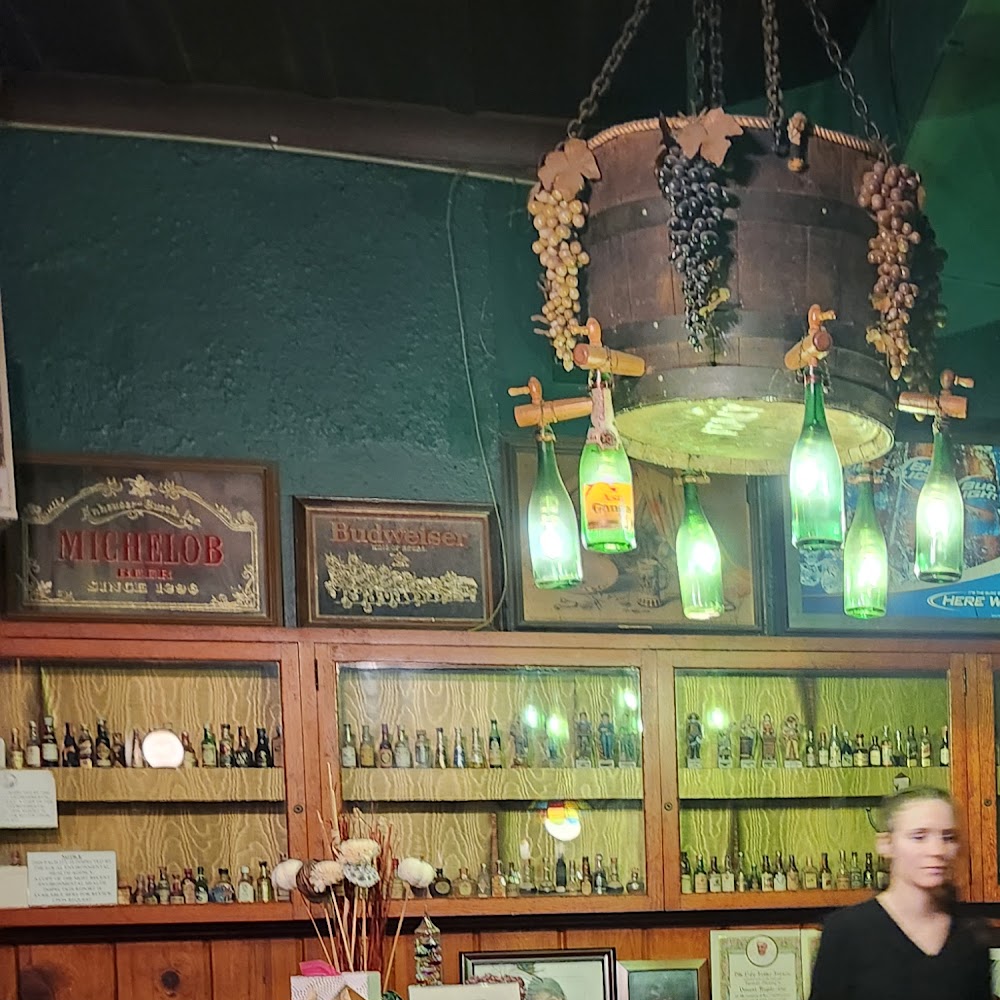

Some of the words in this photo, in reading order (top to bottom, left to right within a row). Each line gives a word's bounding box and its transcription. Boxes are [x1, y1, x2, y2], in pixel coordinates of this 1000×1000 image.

[963, 490, 998, 501] IGHT
[329, 520, 470, 548] Budweiser
[58, 529, 225, 567] MICHELOB
[87, 580, 148, 595] SINCE
[942, 594, 986, 607] HERE
